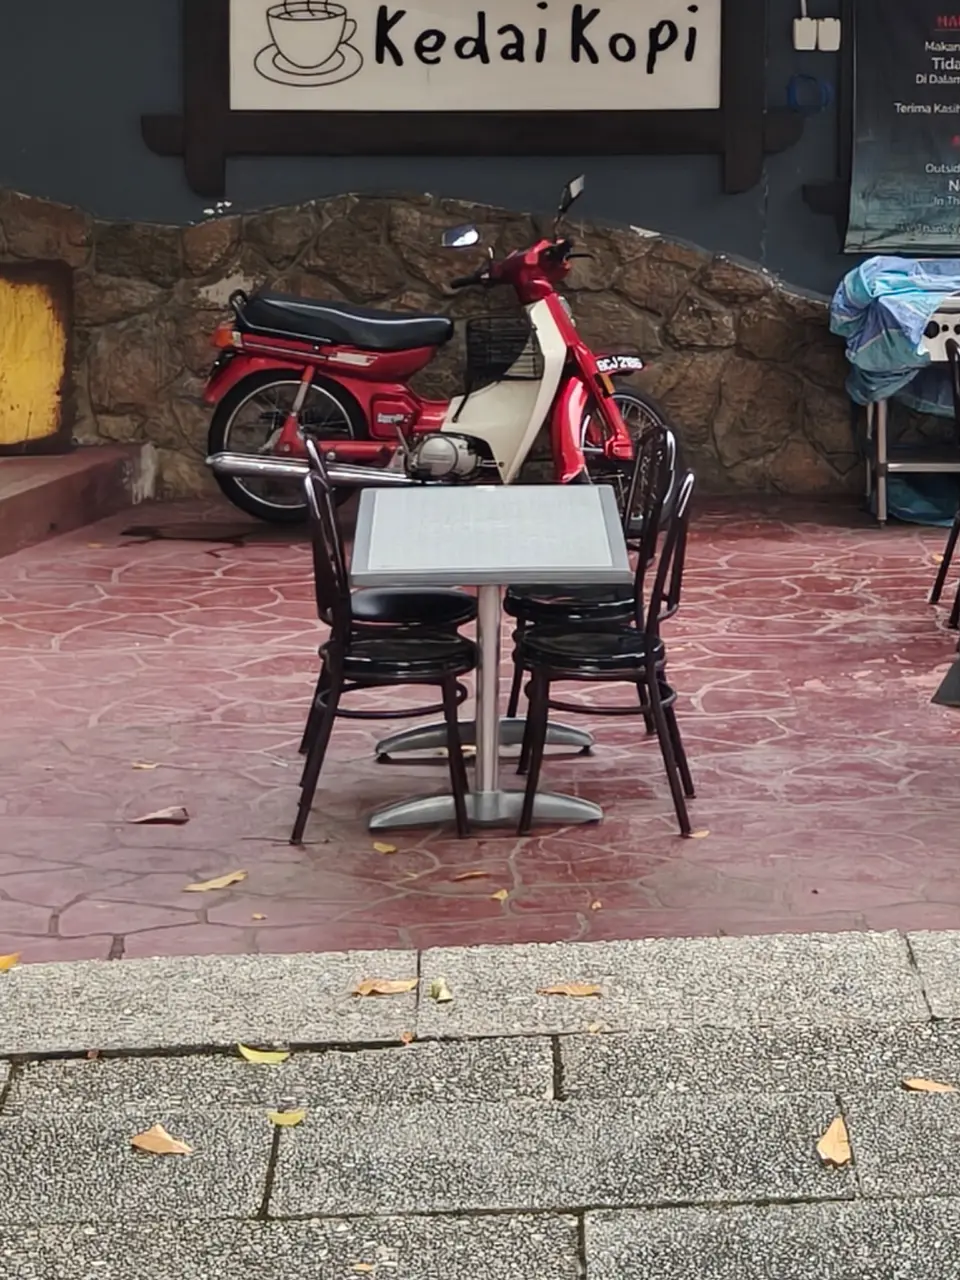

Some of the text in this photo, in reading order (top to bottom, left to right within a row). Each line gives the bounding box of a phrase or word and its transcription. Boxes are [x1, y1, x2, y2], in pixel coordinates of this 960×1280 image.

[375, 1, 700, 74] Kedai Kopi
[916, 74, 927, 84] Di
[895, 103, 931, 114] Terima
